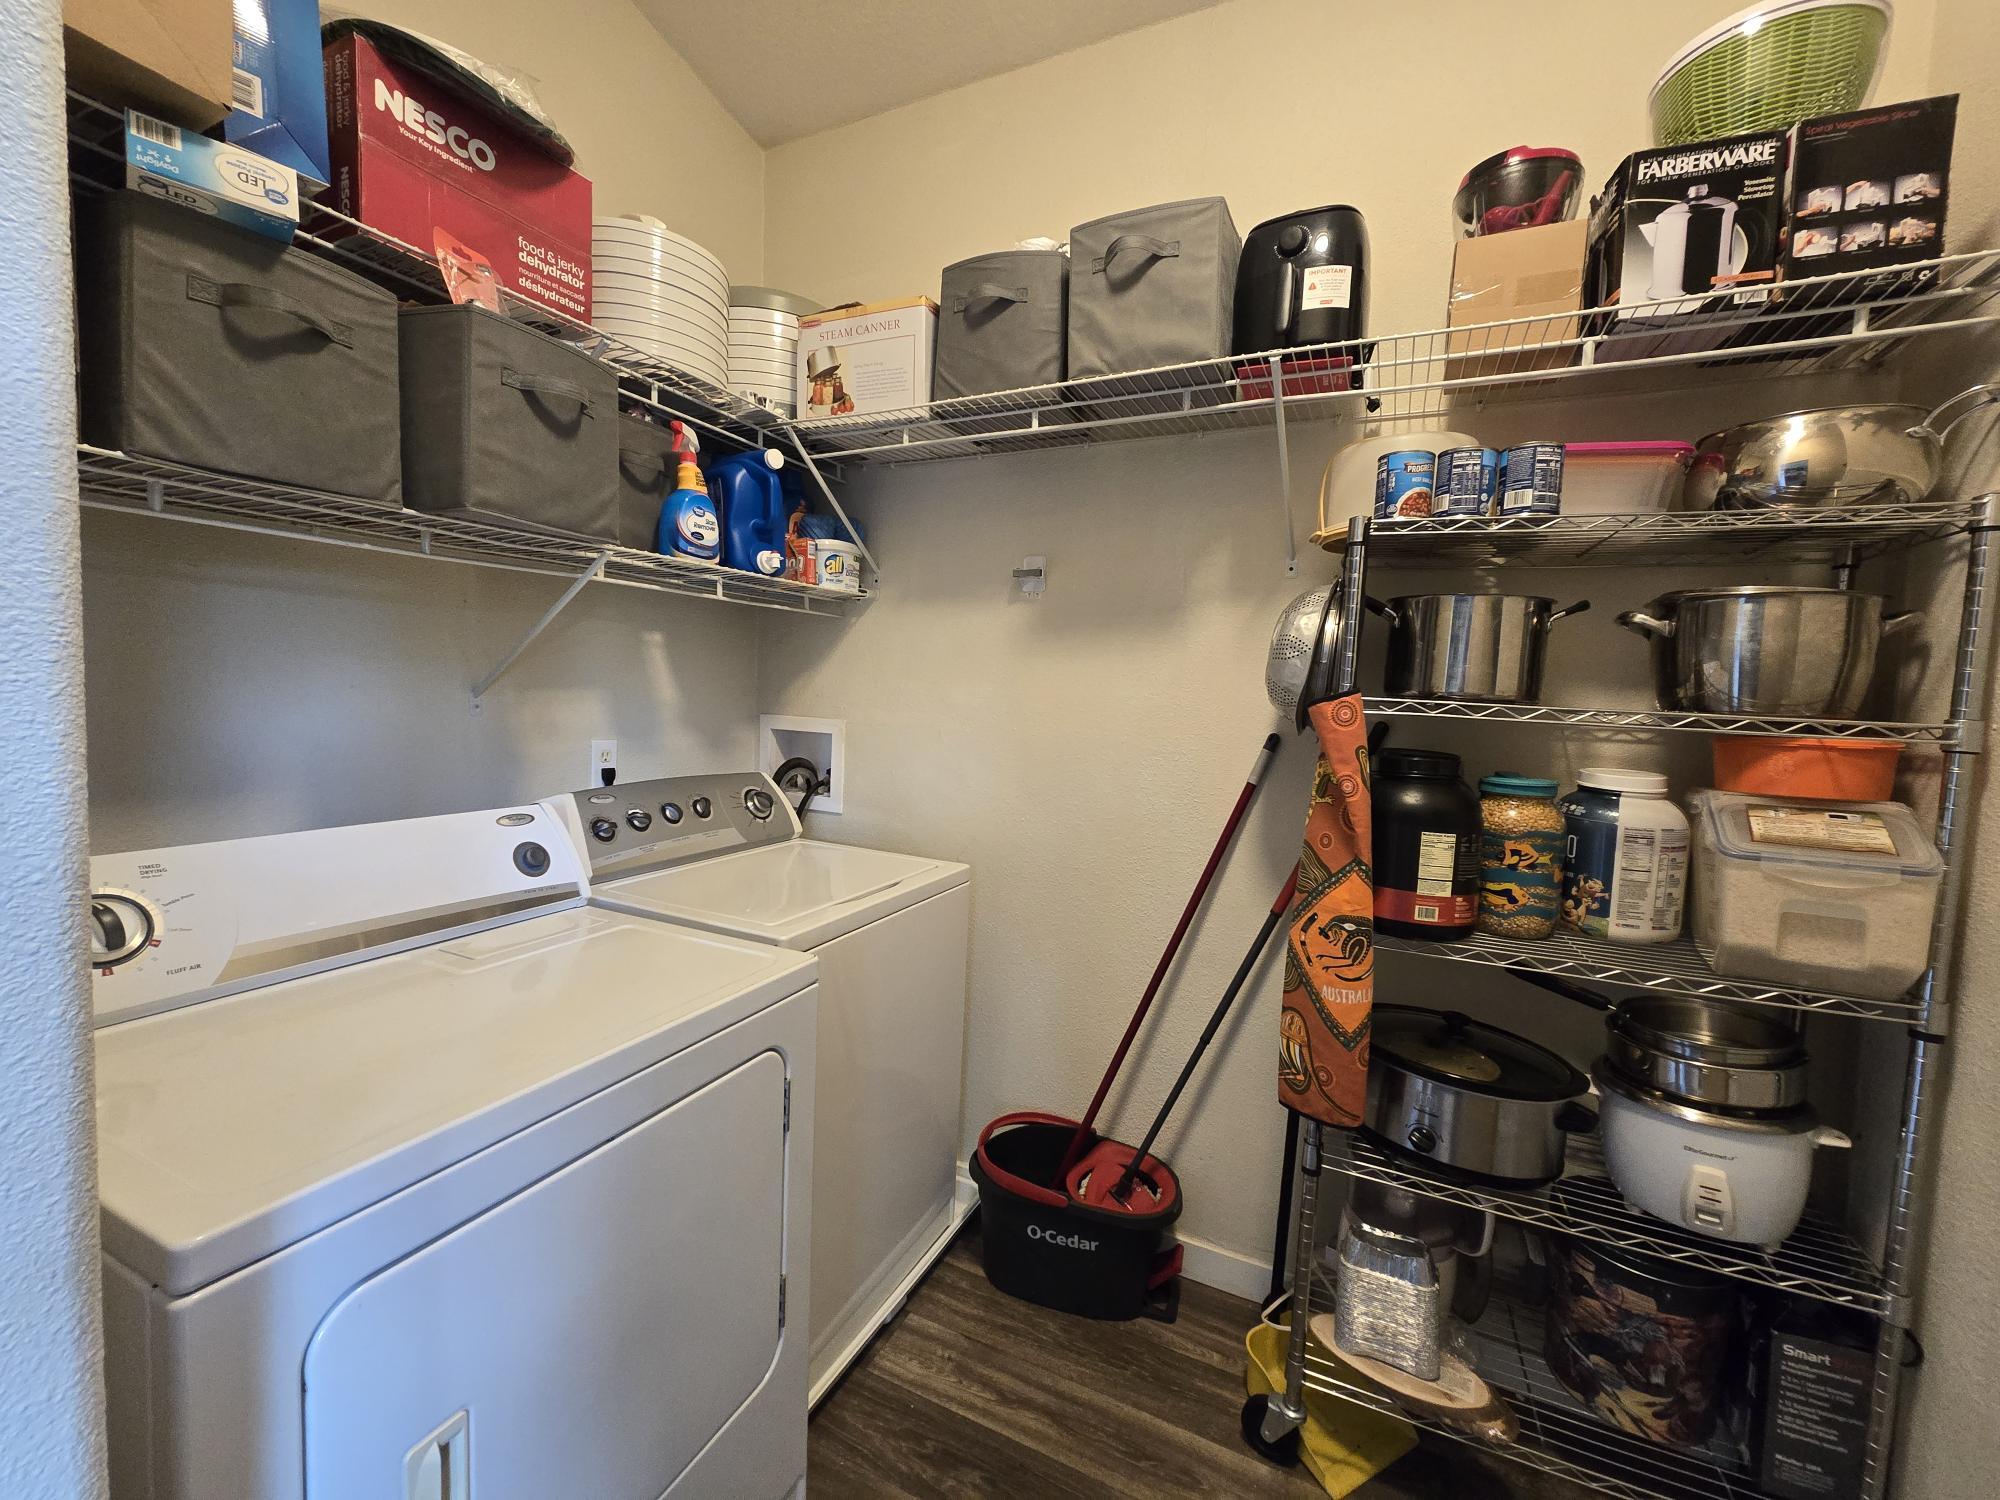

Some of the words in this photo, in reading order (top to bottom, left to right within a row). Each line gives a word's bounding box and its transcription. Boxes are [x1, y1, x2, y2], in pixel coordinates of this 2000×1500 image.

[374, 78, 496, 171] NESCO
[398, 125, 421, 141] Your
[418, 136, 433, 152] Key
[434, 145, 475, 173] Ingredient
[135, 153, 179, 174] Daylight
[1637, 142, 1777, 181] FARBERWARE
[237, 171, 267, 190] LED
[1682, 166, 1731, 179] GENERATION
[165, 187, 197, 204] LED
[518, 235, 545, 259] food
[547, 251, 556, 264] &
[557, 255, 585, 279] jerky
[518, 251, 585, 289] dehydrator
[1308, 267, 1347, 277] IMPORTANT
[518, 276, 586, 313] déshydrateur
[819, 327, 853, 342] STEAM
[855, 319, 901, 336] CANNER
[826, 556, 844, 575] all
[138, 863, 161, 871] TIMED
[139, 867, 168, 876] DRYING
[166, 966, 188, 976] FLUFF
[189, 963, 202, 972] AIR
[1321, 984, 1374, 1005] AUSTRALI
[1027, 1224, 1099, 1251] O-Cedar
[1782, 1344, 1832, 1367] Smart
